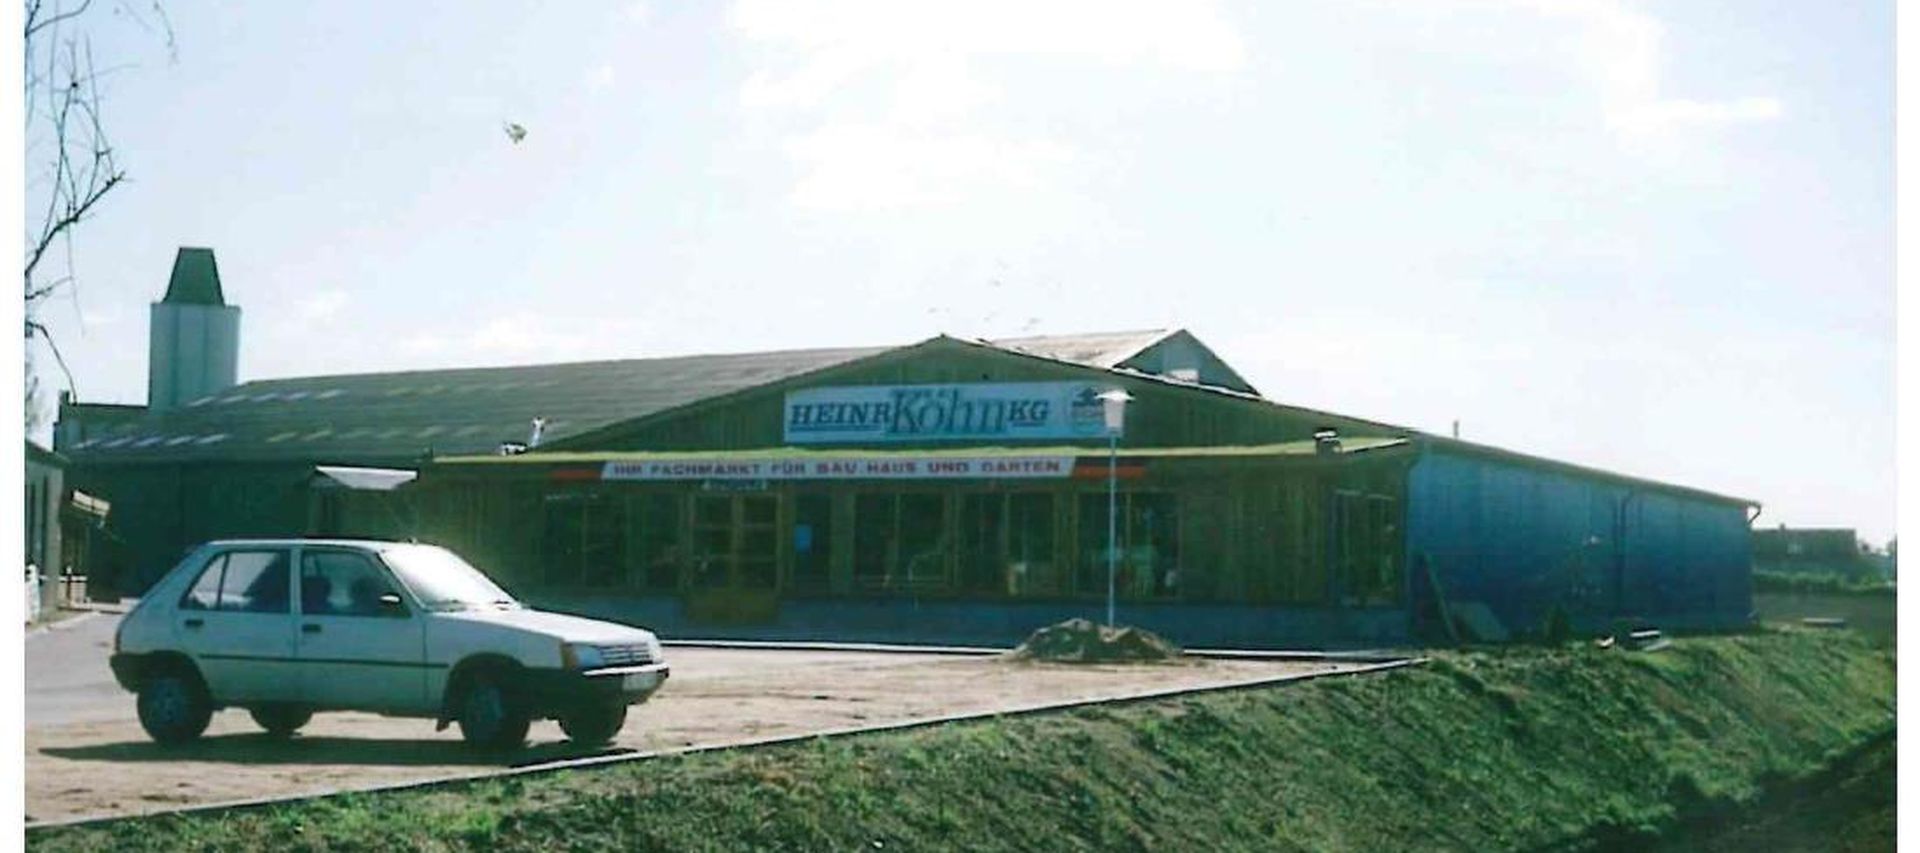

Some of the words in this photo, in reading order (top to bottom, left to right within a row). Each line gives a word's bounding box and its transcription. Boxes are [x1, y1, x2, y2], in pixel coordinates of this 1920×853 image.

[890, 386, 1006, 434] Köhn
[1008, 400, 1048, 421] KG
[650, 463, 760, 475] FACHMARKT
[771, 461, 805, 474] FÜR
[815, 462, 857, 474] BAU
[867, 461, 916, 473] HAUS
[927, 461, 970, 472] UND
[981, 460, 1060, 473] GARTEN
